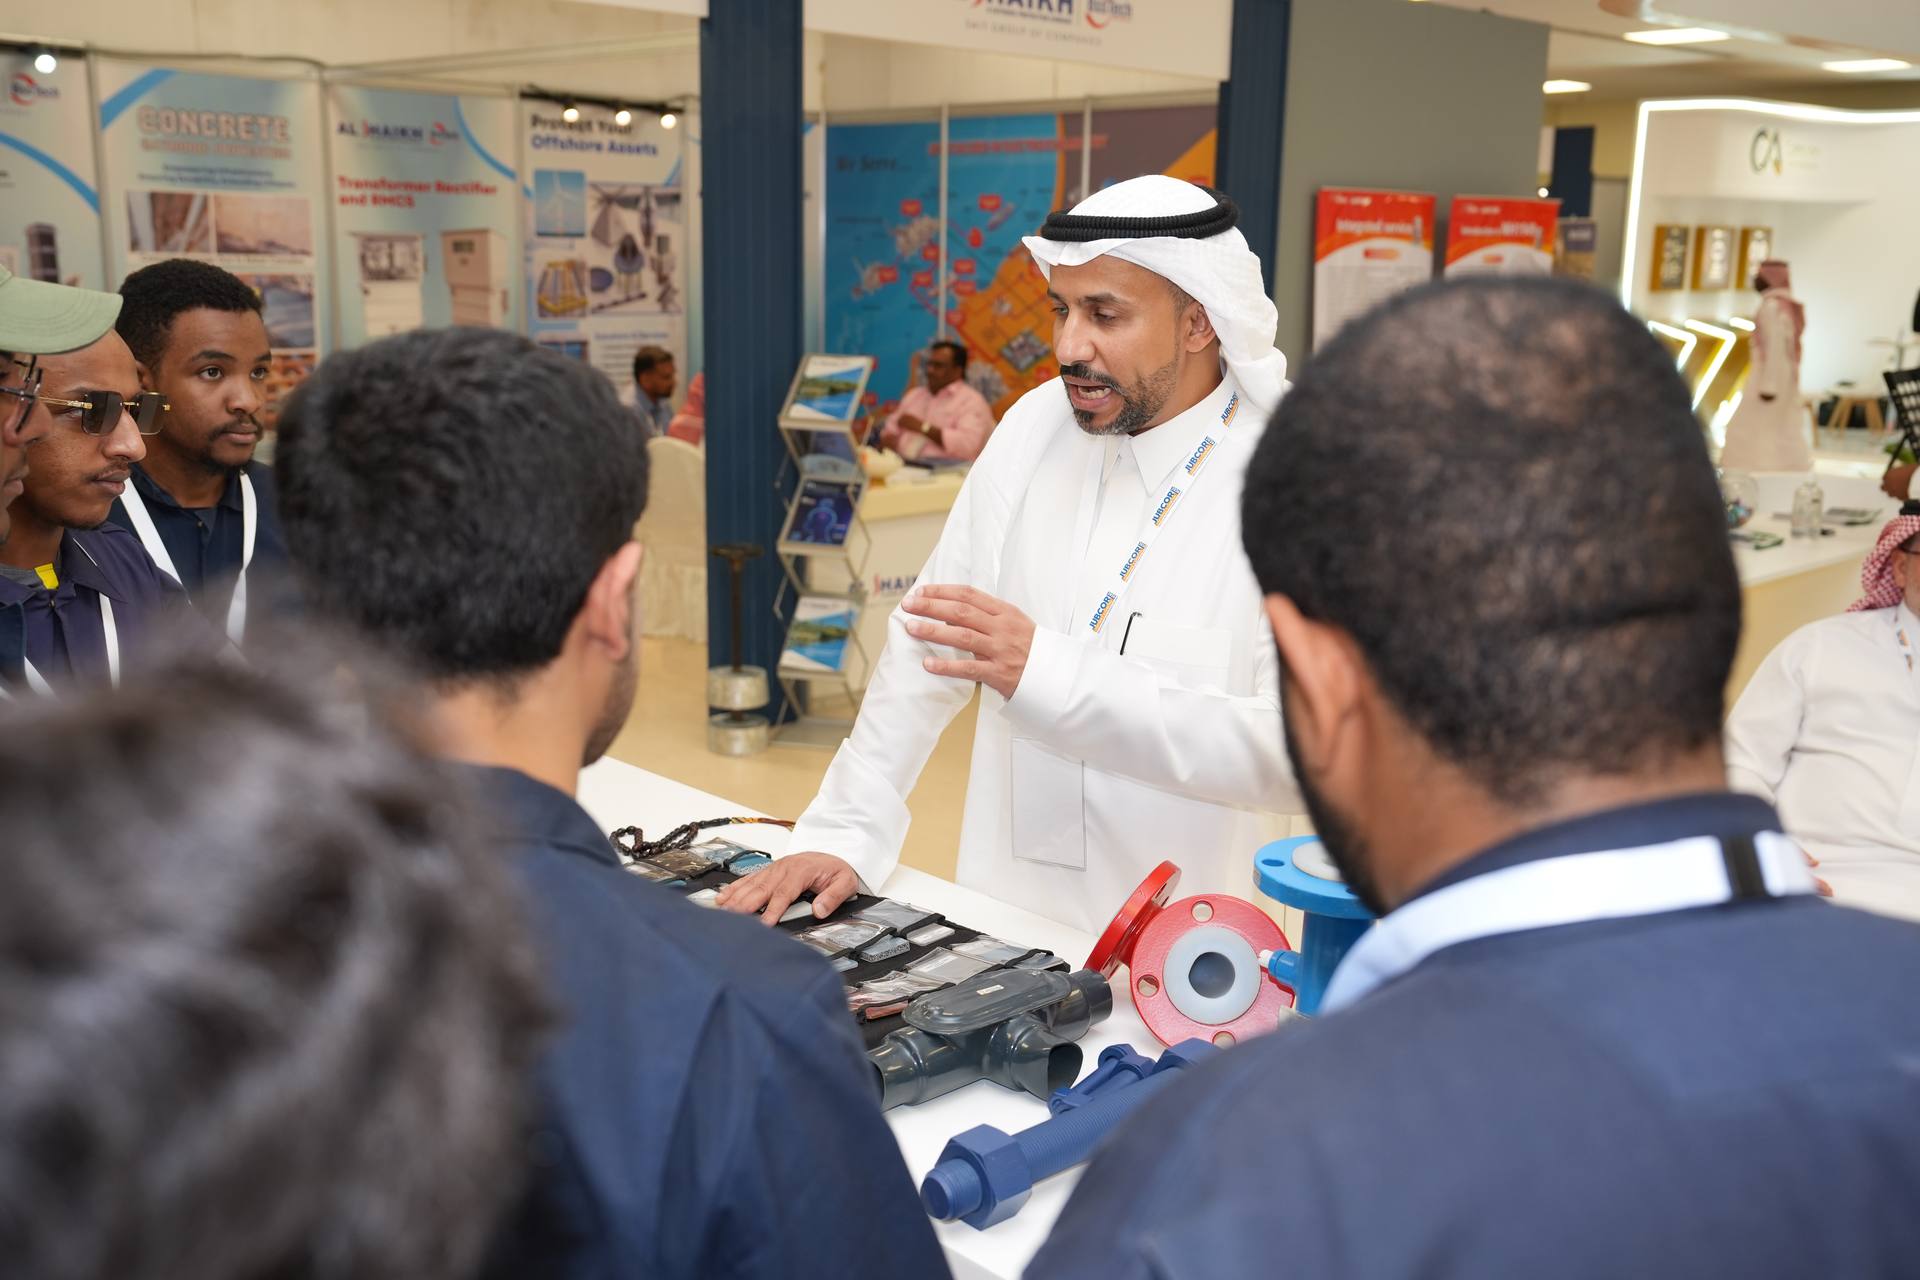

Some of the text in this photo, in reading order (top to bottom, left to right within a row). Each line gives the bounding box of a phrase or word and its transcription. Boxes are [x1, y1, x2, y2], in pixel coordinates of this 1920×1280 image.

[137, 105, 290, 143] CONCRETE
[531, 134, 657, 155] Offshore Assets
[338, 175, 497, 194] Transformer Rectifier
[339, 194, 367, 206] and
